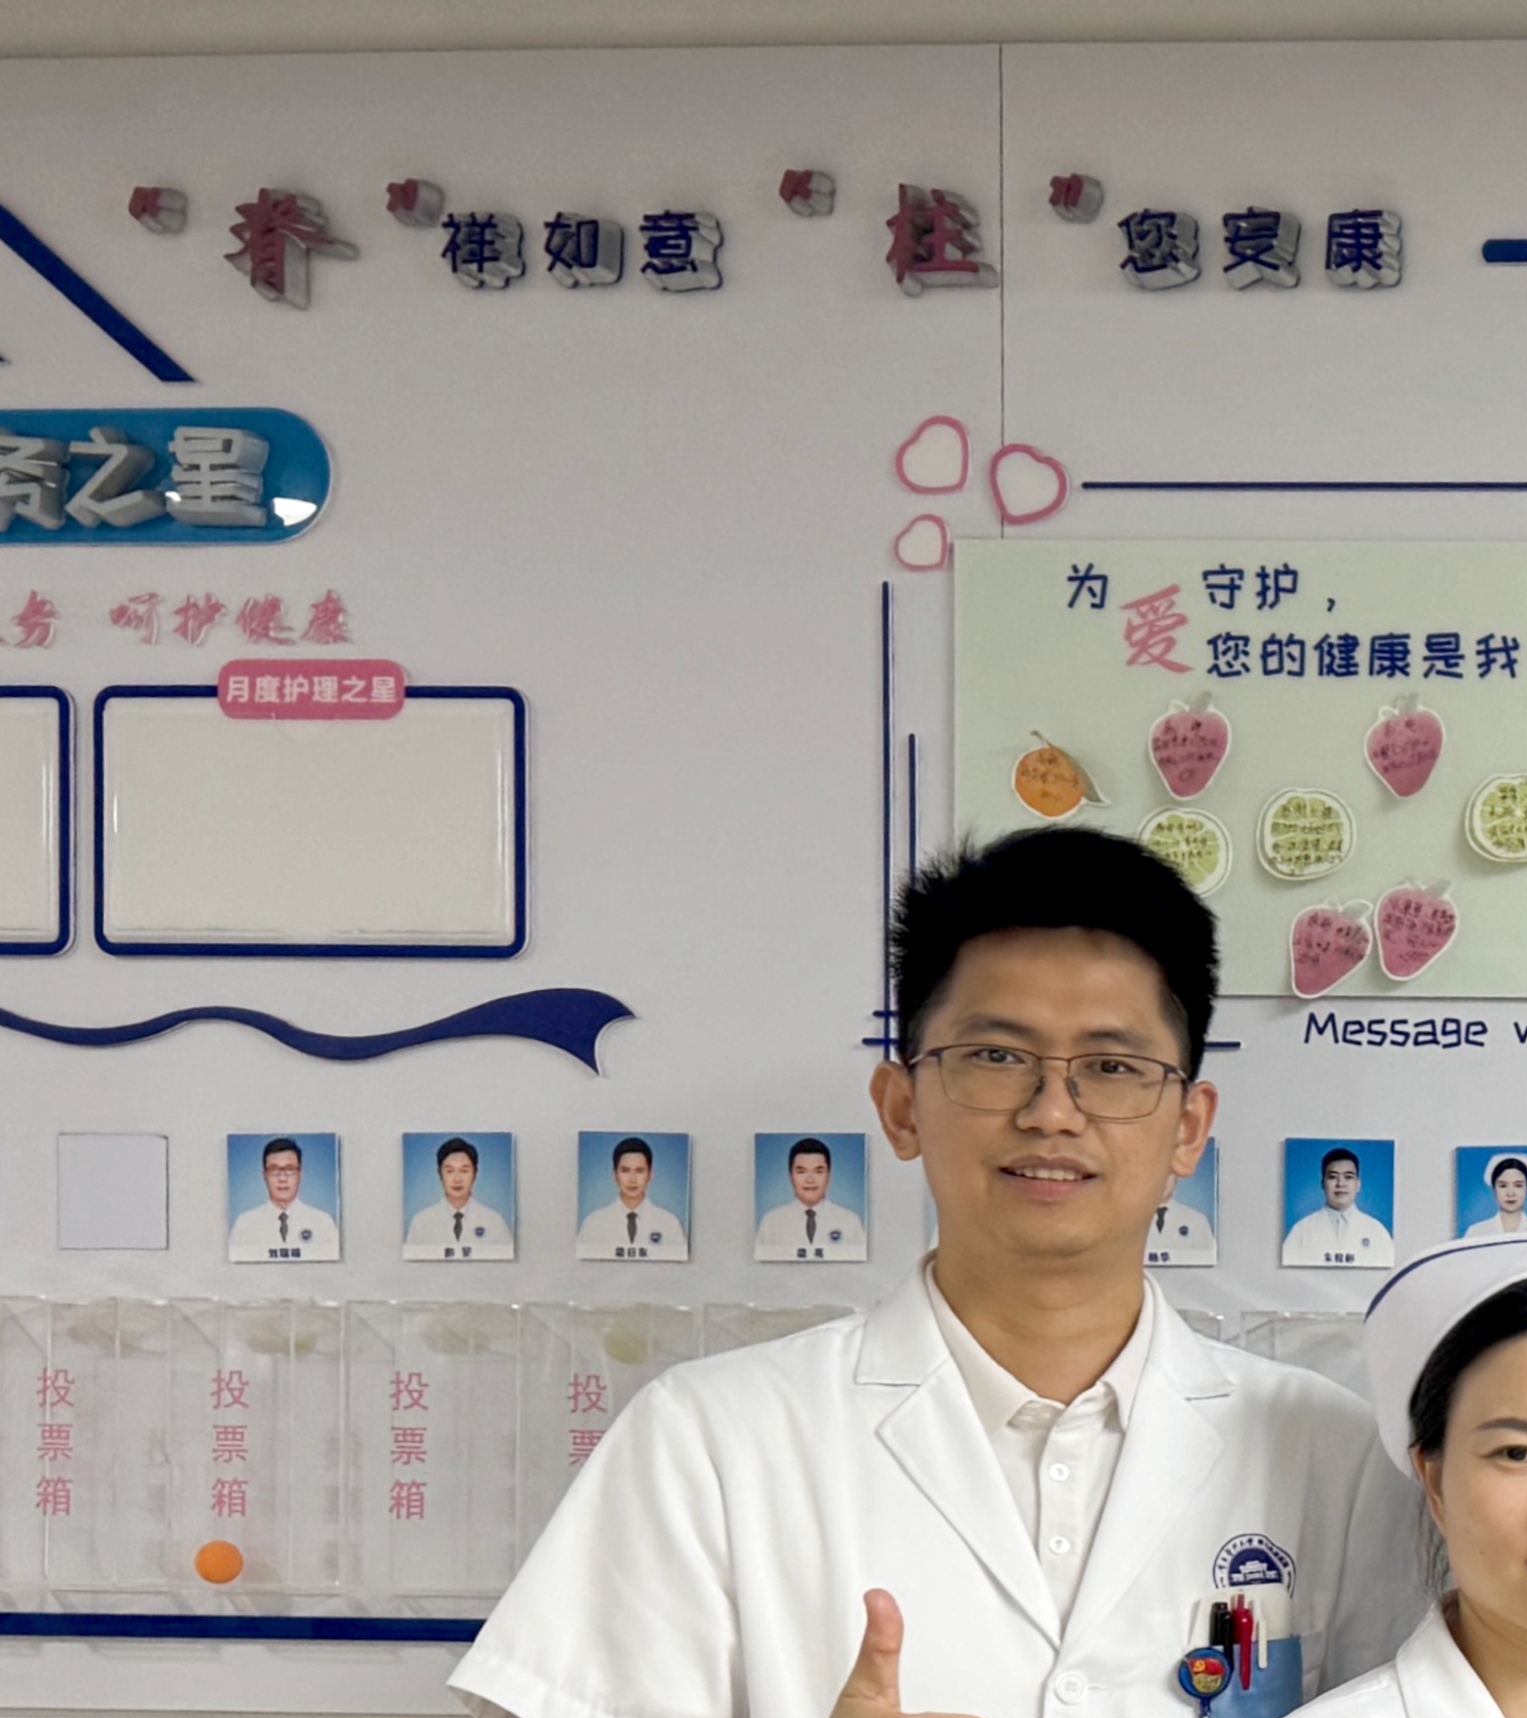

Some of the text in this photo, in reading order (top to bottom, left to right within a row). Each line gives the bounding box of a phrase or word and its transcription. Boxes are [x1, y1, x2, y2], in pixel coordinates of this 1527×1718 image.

[0, 589, 60, 648] 务
[226, 674, 397, 704] 月度护理之星
[1303, 1012, 1489, 1050] Message
[36, 1367, 76, 1517] 投票箱
[210, 1367, 250, 1518] 投票箱
[388, 1369, 429, 1521] 投票箱
